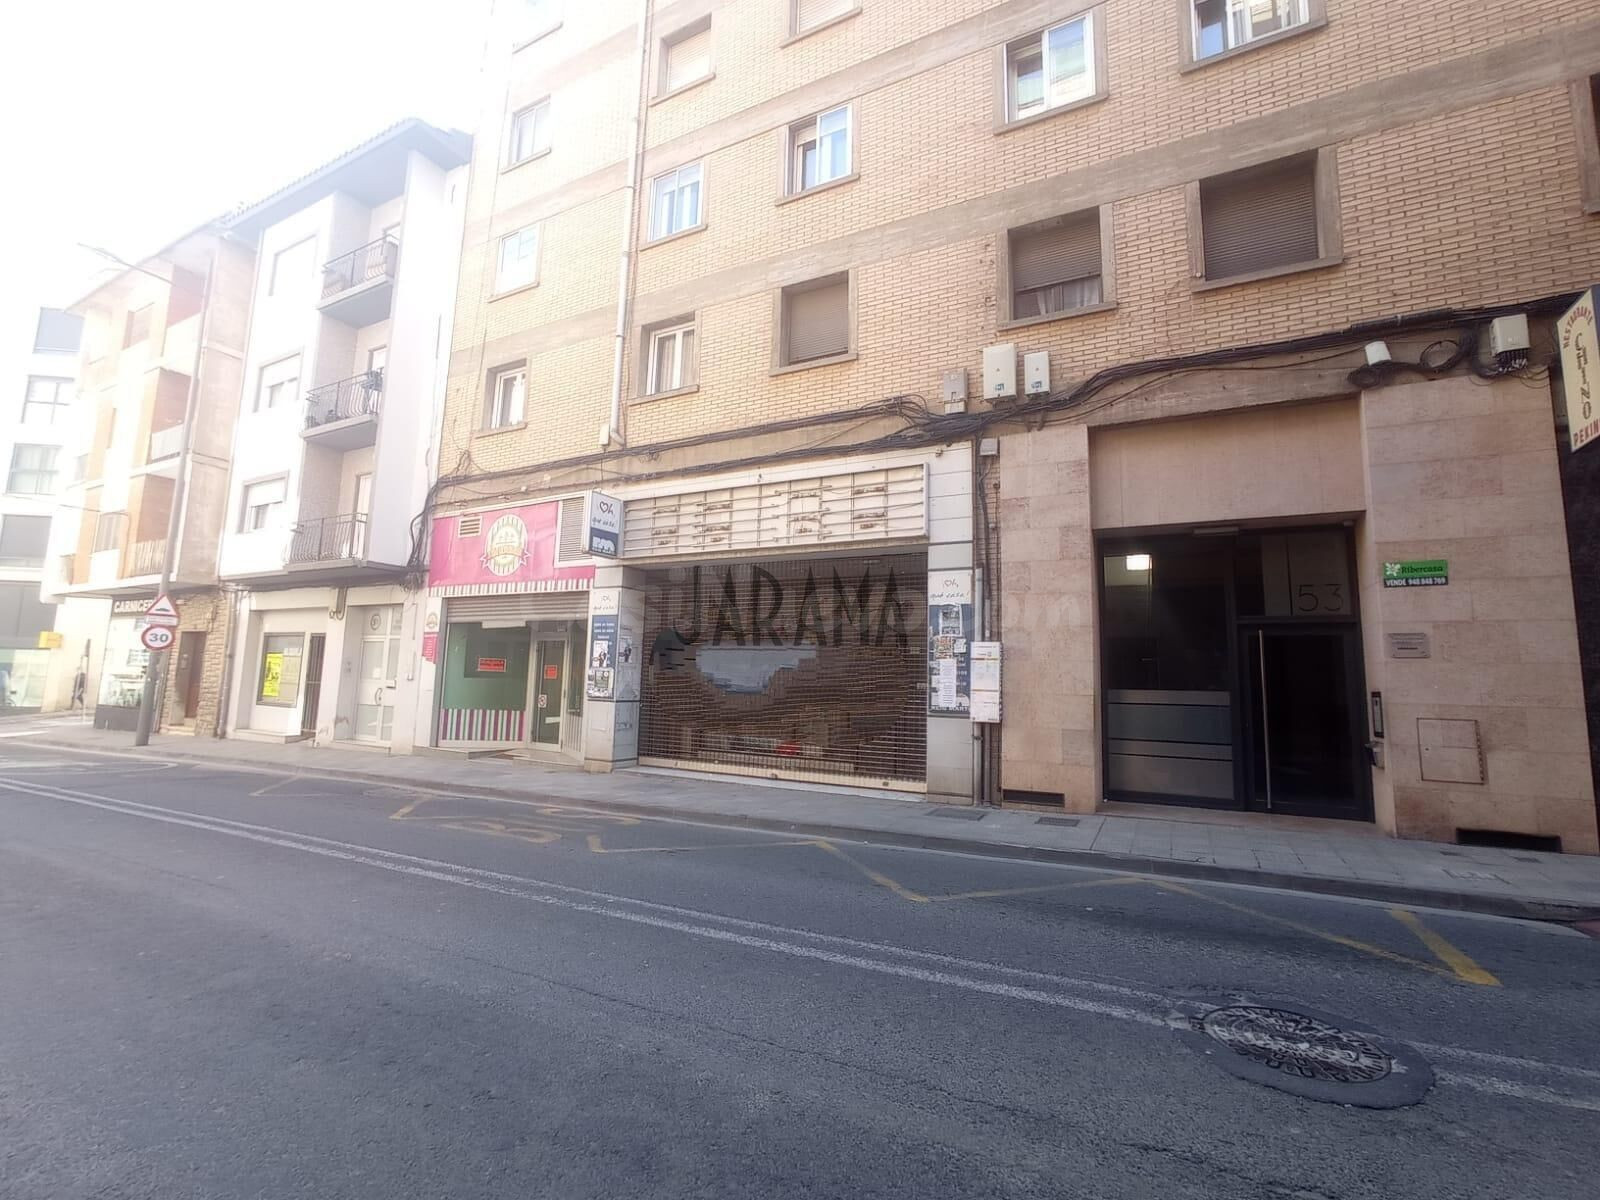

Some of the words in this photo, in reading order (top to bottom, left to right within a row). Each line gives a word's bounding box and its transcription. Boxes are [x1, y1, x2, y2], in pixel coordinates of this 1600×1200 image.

[1401, 565, 1444, 574] Ribercasa
[1385, 579, 1407, 587] VENDE
[1298, 583, 1345, 612] 53
[672, 564, 909, 647] JARAMA
[149, 632, 169, 643] 30
